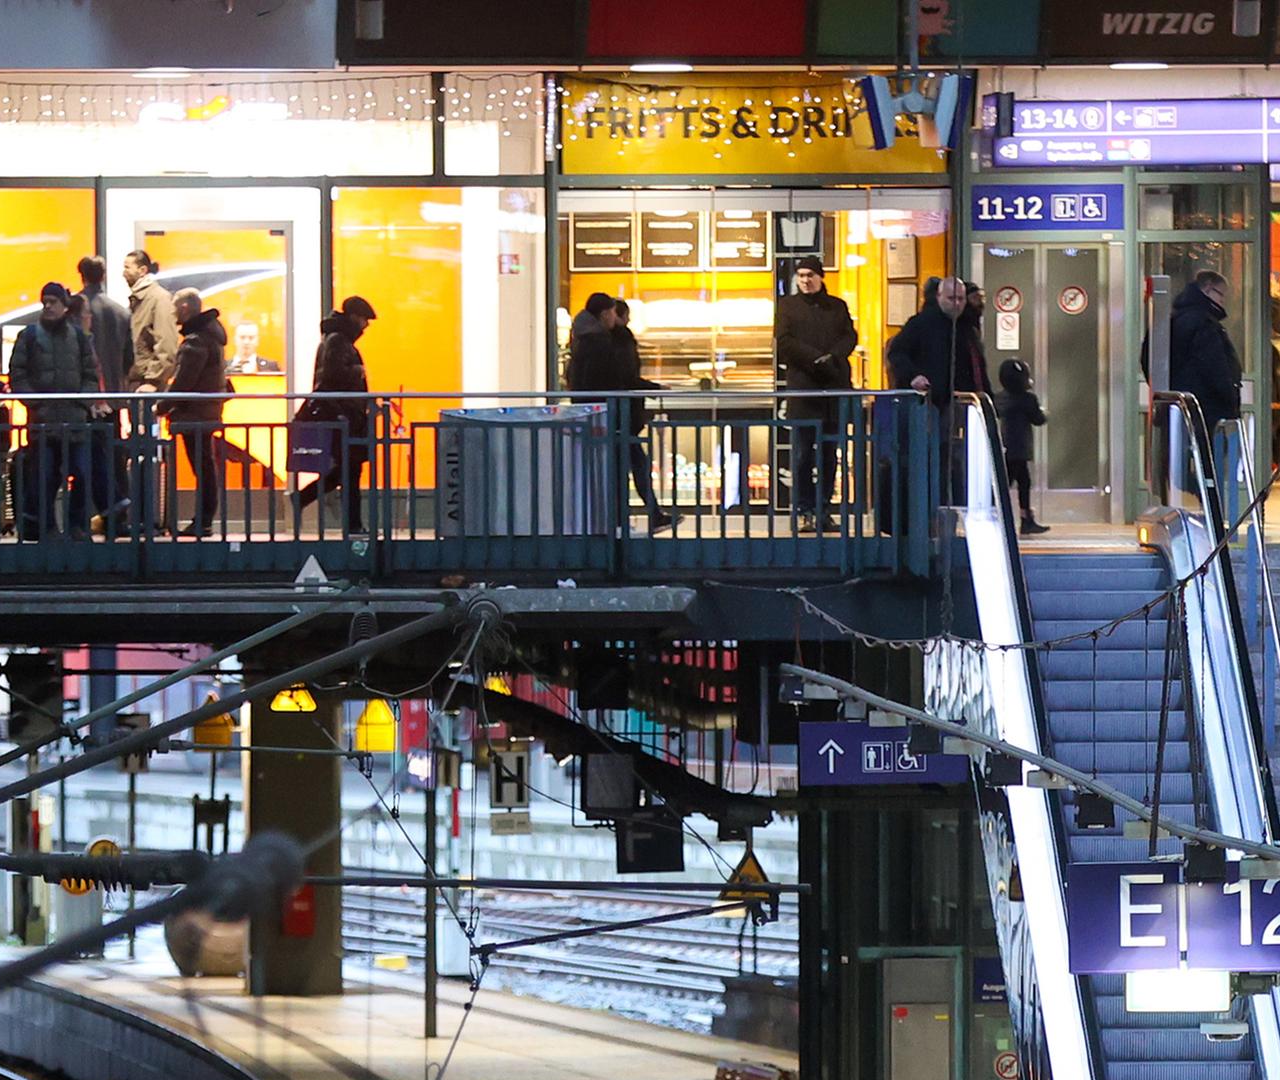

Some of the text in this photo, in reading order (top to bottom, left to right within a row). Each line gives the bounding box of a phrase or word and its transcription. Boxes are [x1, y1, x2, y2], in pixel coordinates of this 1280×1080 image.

[1102, 12, 1216, 35] WITZIG
[585, 105, 720, 140] FRITTS
[731, 105, 759, 140] &
[1019, 108, 1078, 130] 13-14
[978, 196, 1043, 220] 11-12
[1120, 873, 1167, 947] E
